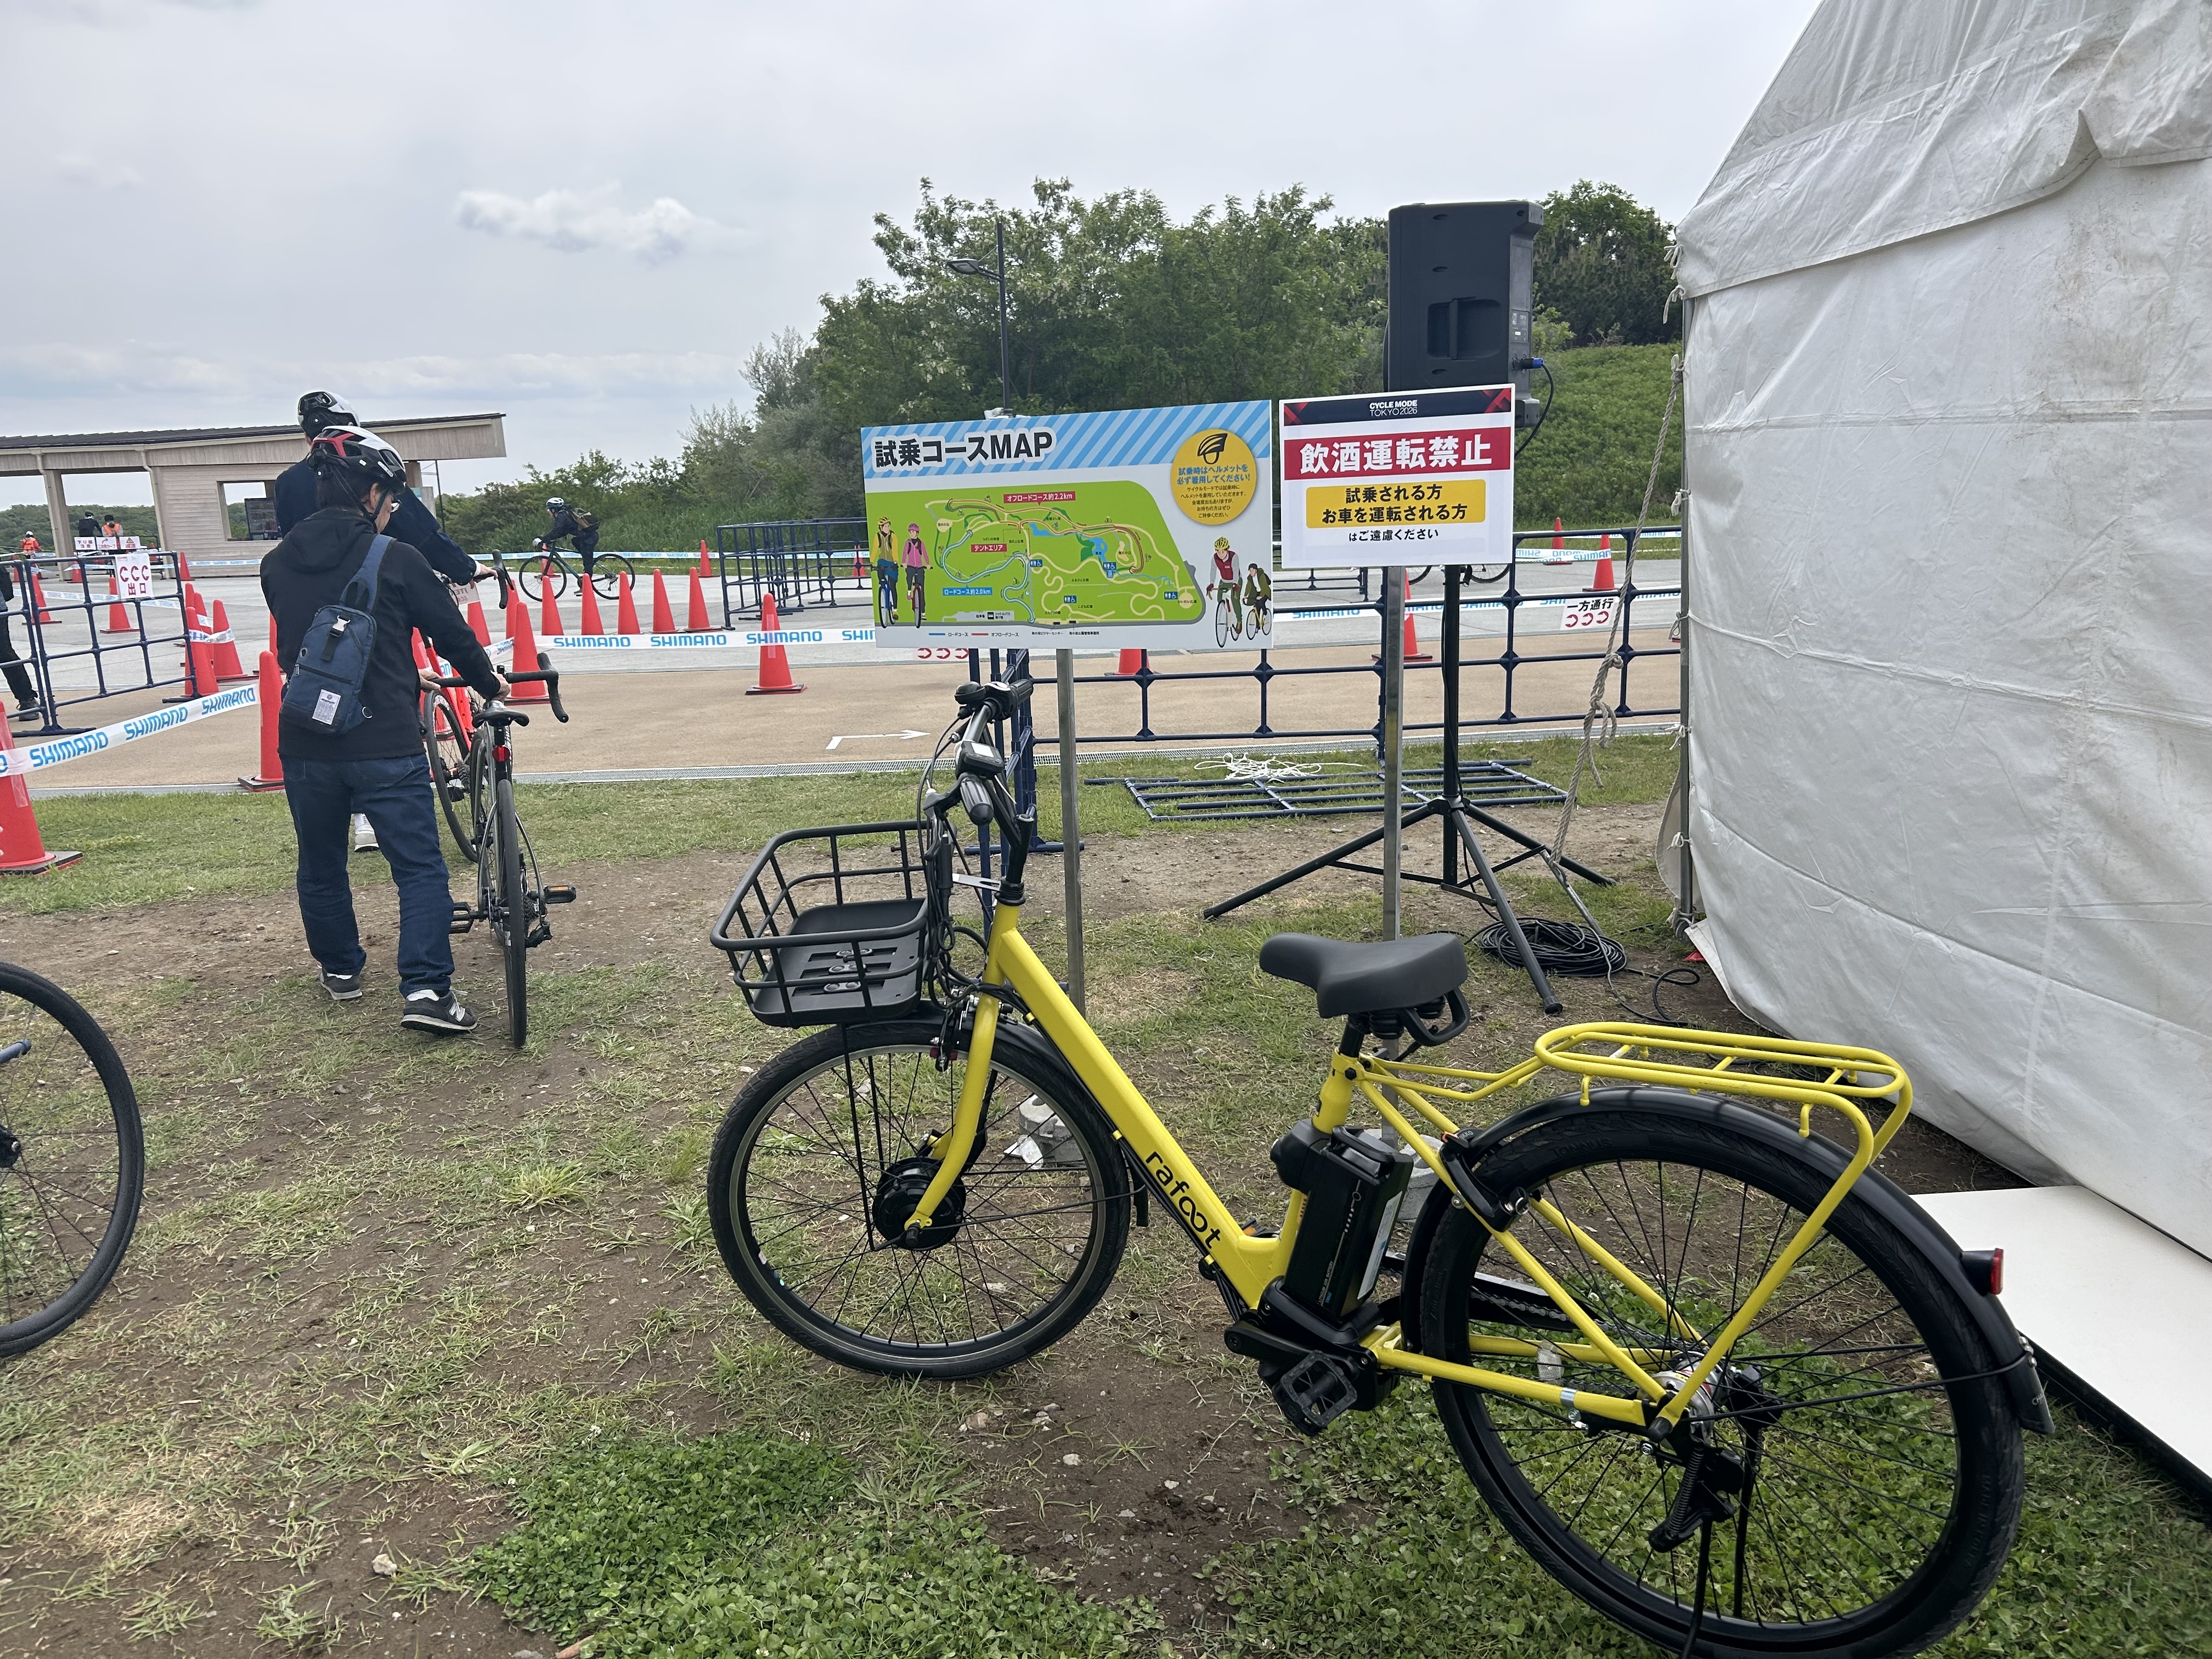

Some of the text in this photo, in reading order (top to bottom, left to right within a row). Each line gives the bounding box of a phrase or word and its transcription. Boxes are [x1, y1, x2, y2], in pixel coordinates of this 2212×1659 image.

[1369, 399, 1418, 410] CYCLE MODE
[1369, 407, 1418, 417] TOKYO 2026
[874, 432, 1053, 468] 試乗コースMAP
[1300, 434, 1492, 475] 飲酒運転禁止
[1178, 464, 1248, 476] 試乗時はヘルメットを
[1007, 493, 1073, 503] オフロードコース約2.2km
[1345, 483, 1443, 504] 試乗される方
[1322, 503, 1468, 524] お車を運転される方
[1348, 529, 1439, 541] はご遠慮ください
[1573, 550, 1611, 561] SHIMAN
[128, 582, 146, 596] 出口
[1567, 598, 1614, 612] 一方通行
[554, 636, 631, 647] SHIMANO
[651, 634, 727, 647] SHIMANO
[746, 630, 822, 644] SHIMANO
[201, 687, 256, 716] SHIMANO
[124, 706, 189, 741] SHIMANO
[30, 731, 109, 768] SHIMANO
